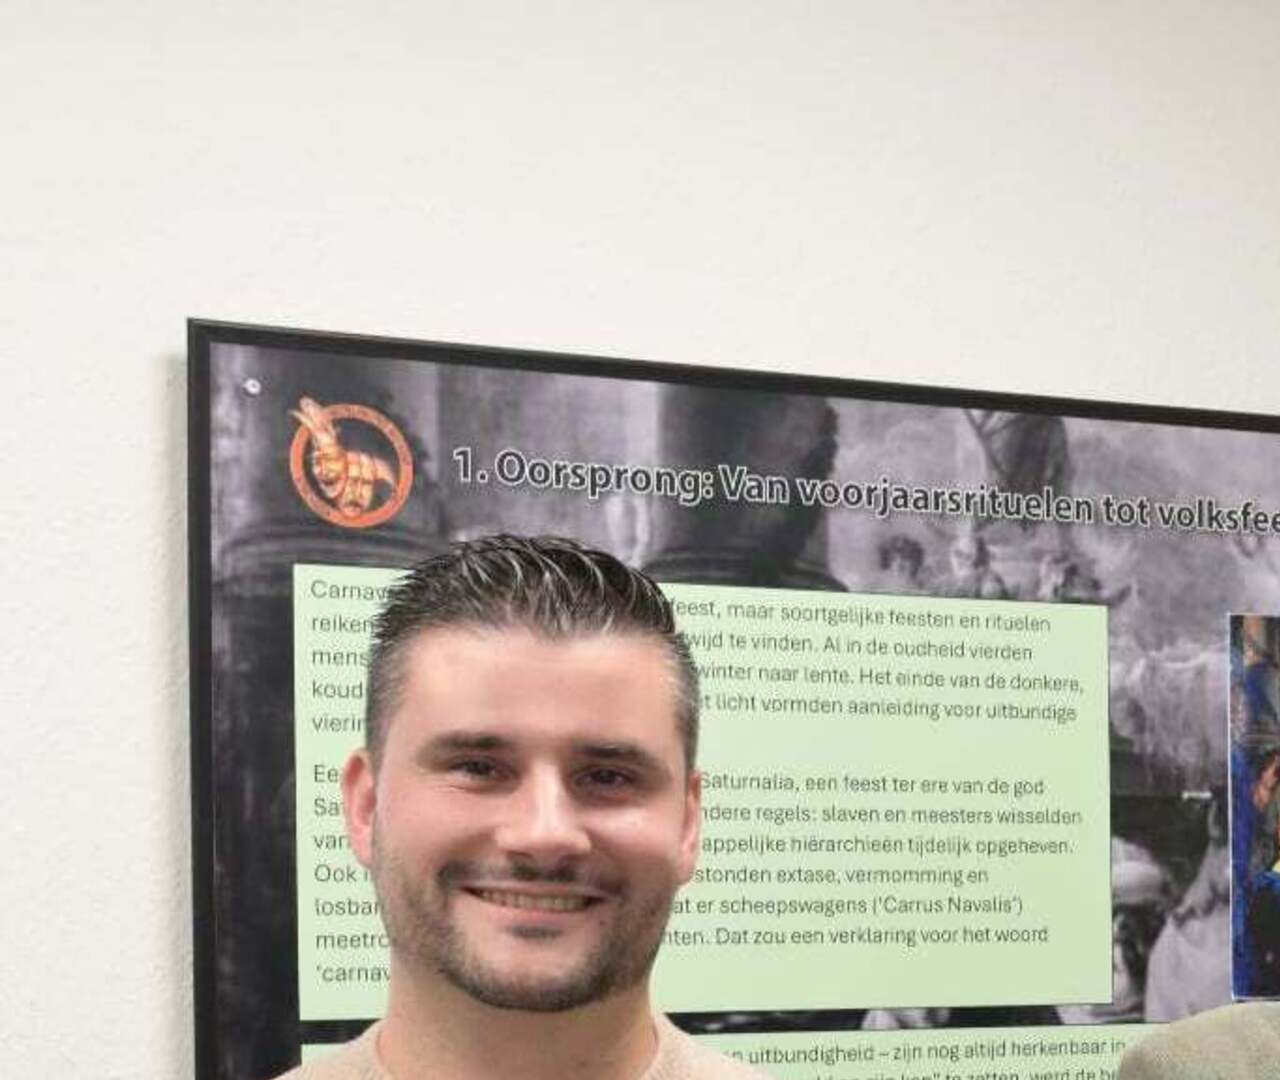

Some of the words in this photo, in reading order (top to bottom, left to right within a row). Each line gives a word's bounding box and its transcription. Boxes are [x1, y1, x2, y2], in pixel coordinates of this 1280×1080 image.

[453, 447, 488, 483] 1.
[495, 450, 715, 505] Oorsprong:
[719, 464, 791, 504] Van
[798, 476, 1094, 524] voorjaarsrituelen
[1103, 496, 1151, 528] tot
[312, 680, 364, 699] koud
[701, 833, 788, 857] appelijke
[695, 899, 716, 915] er
[714, 926, 751, 947] Dat
[751, 929, 788, 946] zou
[789, 929, 825, 945] een
[827, 925, 919, 948] verklaring
[919, 928, 959, 944] voor
[961, 925, 991, 944] het
[993, 925, 1049, 945] woord
[747, 1043, 876, 1067] uitbundigheid
[892, 1043, 923, 1065] zijn
[926, 1043, 961, 1064] nog
[963, 1039, 1007, 1062] altijd
[1010, 1038, 1108, 1058] herkenbaar
